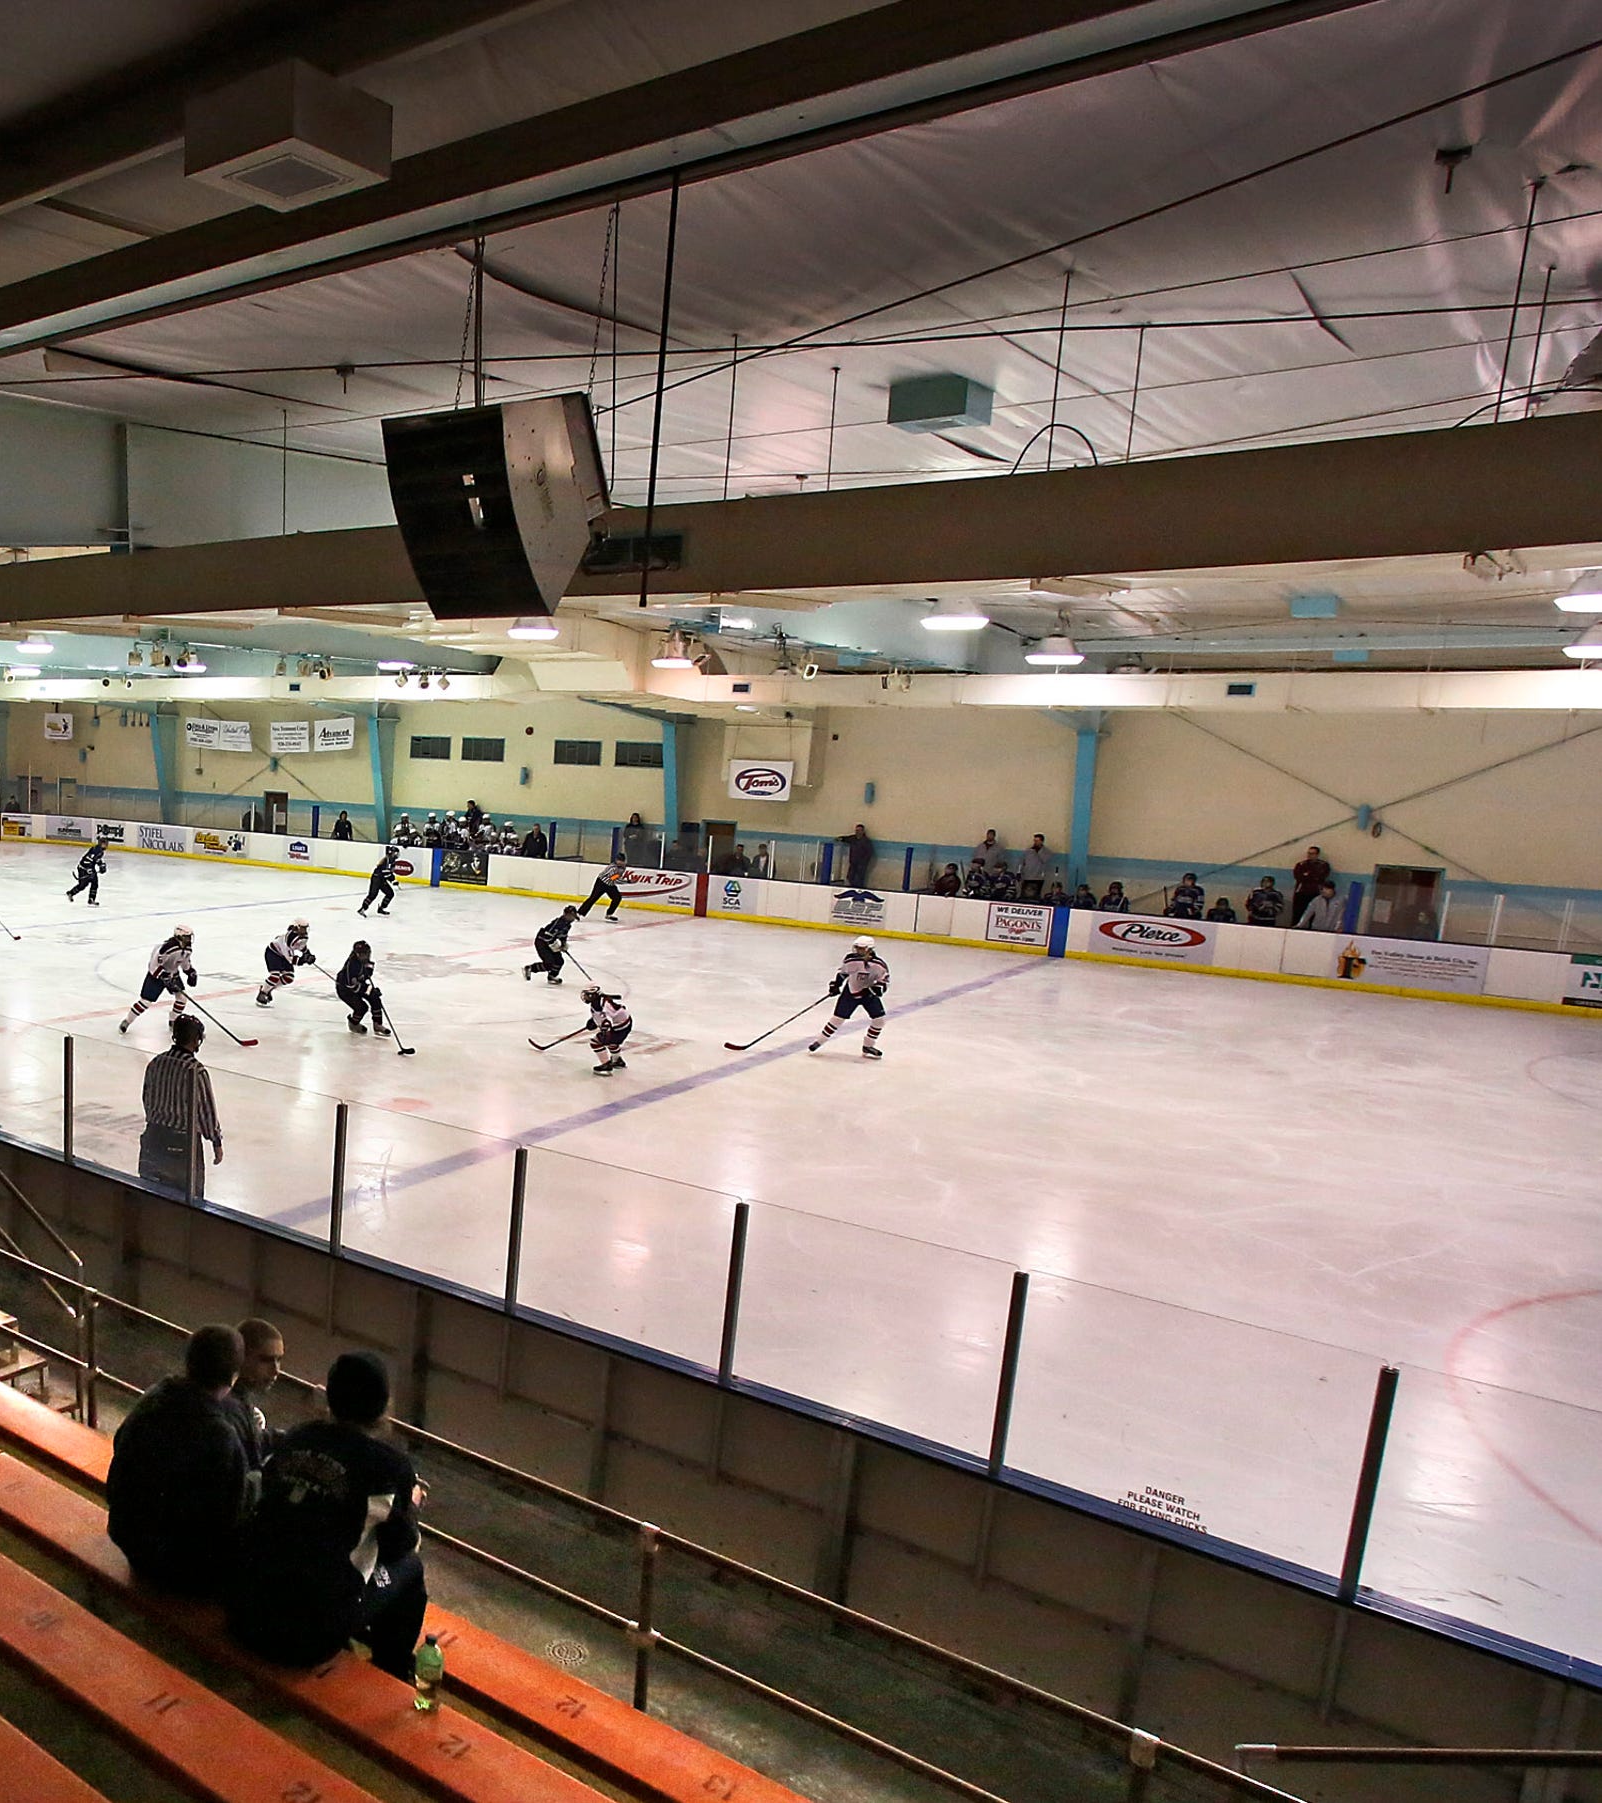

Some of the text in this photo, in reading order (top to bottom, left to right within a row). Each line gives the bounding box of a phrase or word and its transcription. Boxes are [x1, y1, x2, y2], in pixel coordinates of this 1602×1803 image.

[739, 772, 780, 791] Tom's
[139, 825, 164, 839] STIFEL
[142, 839, 185, 853] NICOLAUS
[723, 897, 741, 906] SCA
[1011, 907, 1043, 916] DELIVER
[1122, 923, 1183, 942] Pierce
[1145, 1486, 1185, 1506] DANGER
[1127, 1491, 1200, 1521] PLEASE WATCH
[1118, 1498, 1207, 1534] FOR FLYING PUCKS
